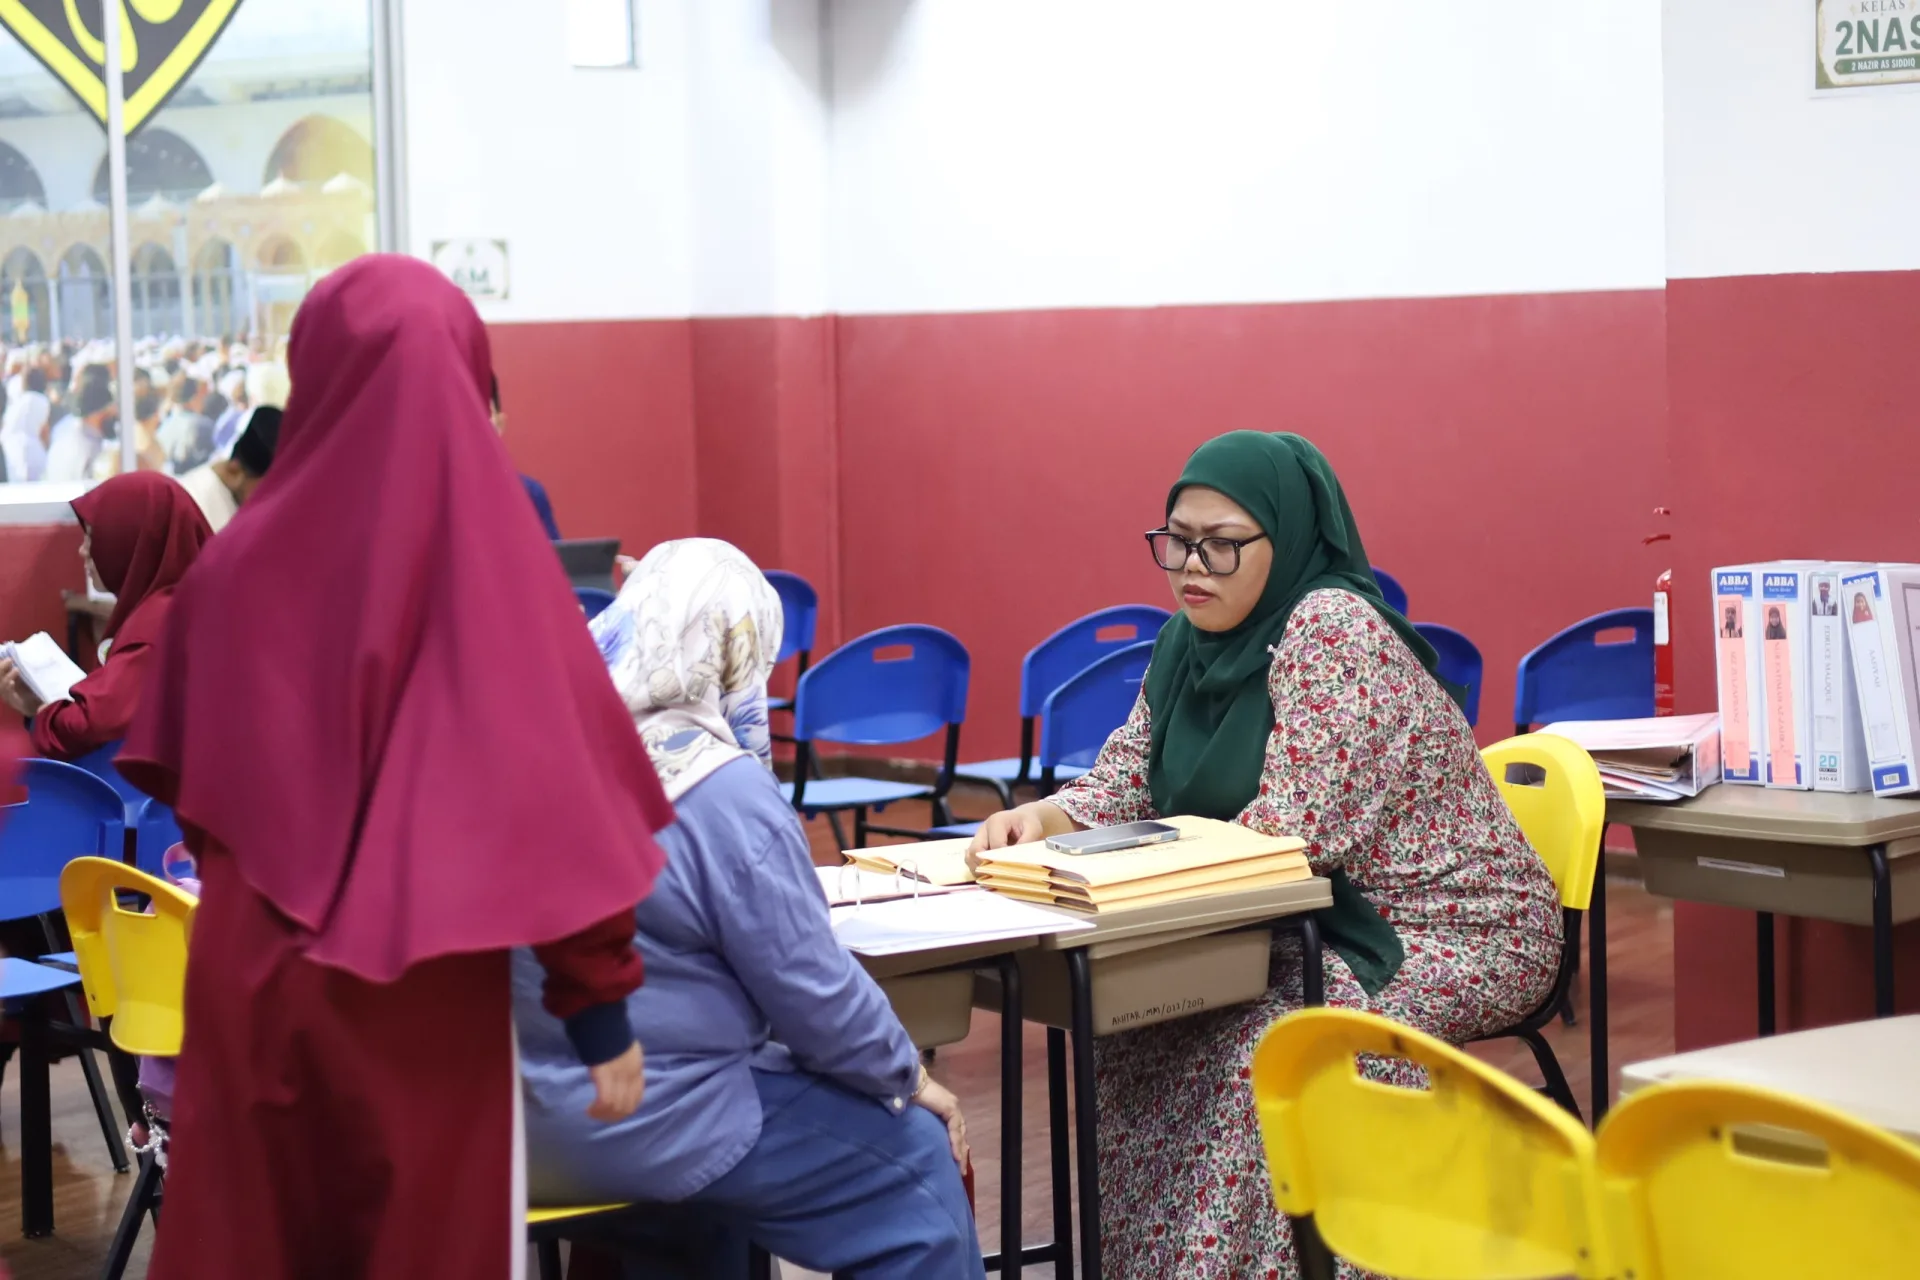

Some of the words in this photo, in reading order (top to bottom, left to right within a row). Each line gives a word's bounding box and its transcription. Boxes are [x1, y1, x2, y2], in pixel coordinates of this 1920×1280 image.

[1861, 0, 1906, 13] KELAS
[1851, 61, 1857, 71] 2
[1857, 60, 1879, 71] NAZIR
[1880, 59, 1890, 69] AS
[1719, 575, 1749, 586] ABBA
[1765, 576, 1795, 587] ABBA
[1819, 755, 1837, 768] 2D
